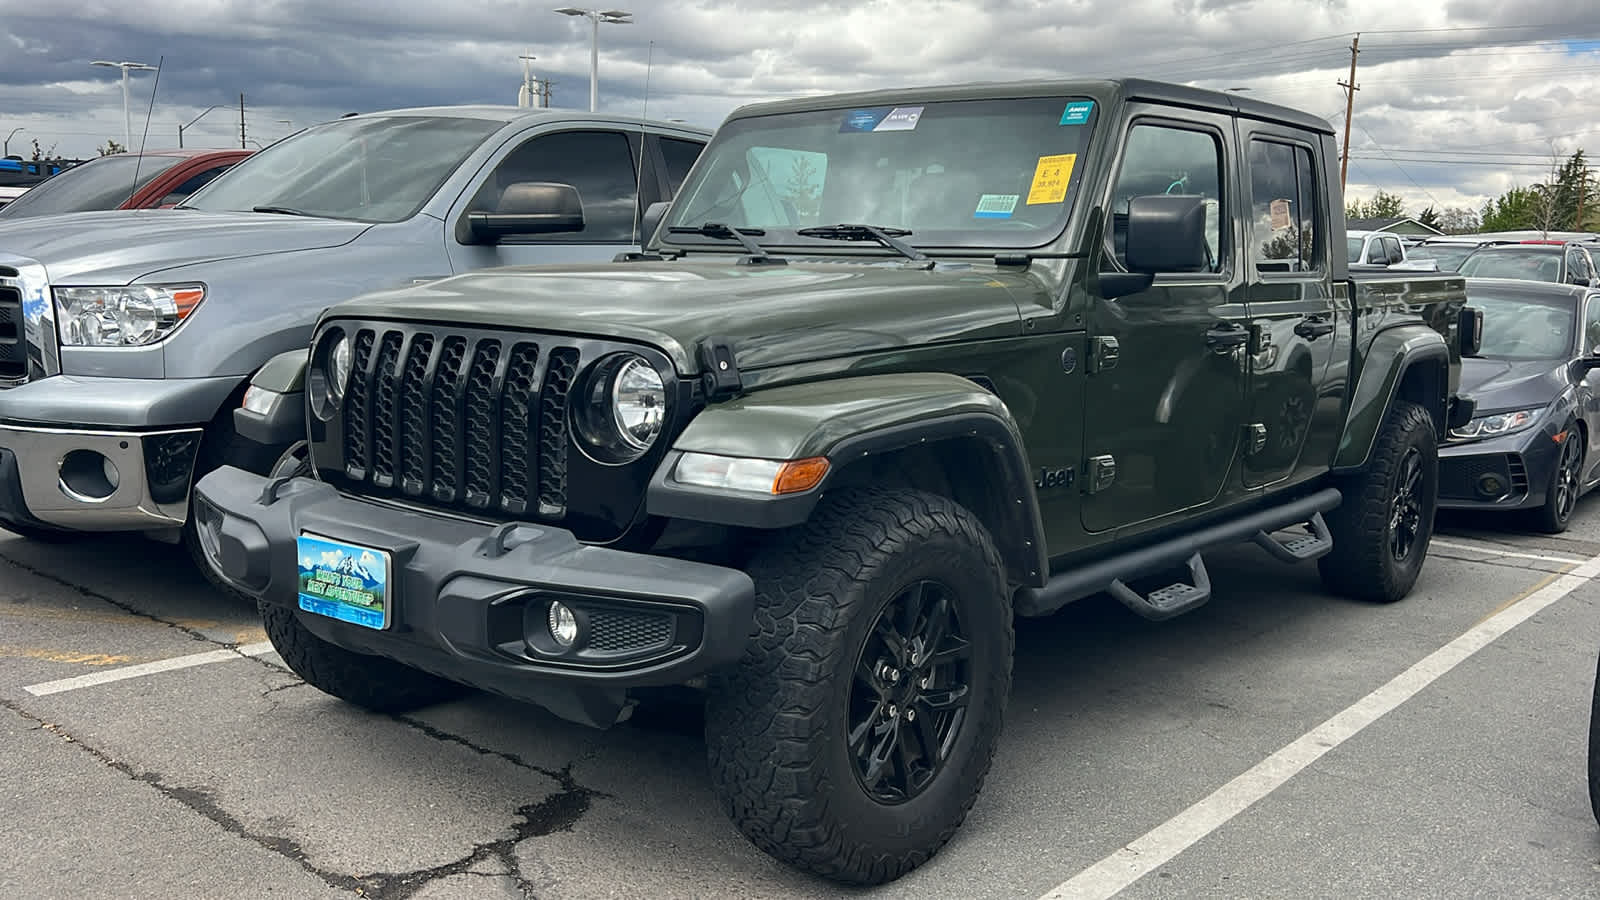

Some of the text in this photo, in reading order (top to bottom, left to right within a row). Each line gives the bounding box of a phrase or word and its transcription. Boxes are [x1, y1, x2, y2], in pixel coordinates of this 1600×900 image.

[1034, 466, 1074, 488] Jeep
[307, 579, 374, 606] NEXT ADVENTURE?
[342, 574, 363, 590] YOUR
